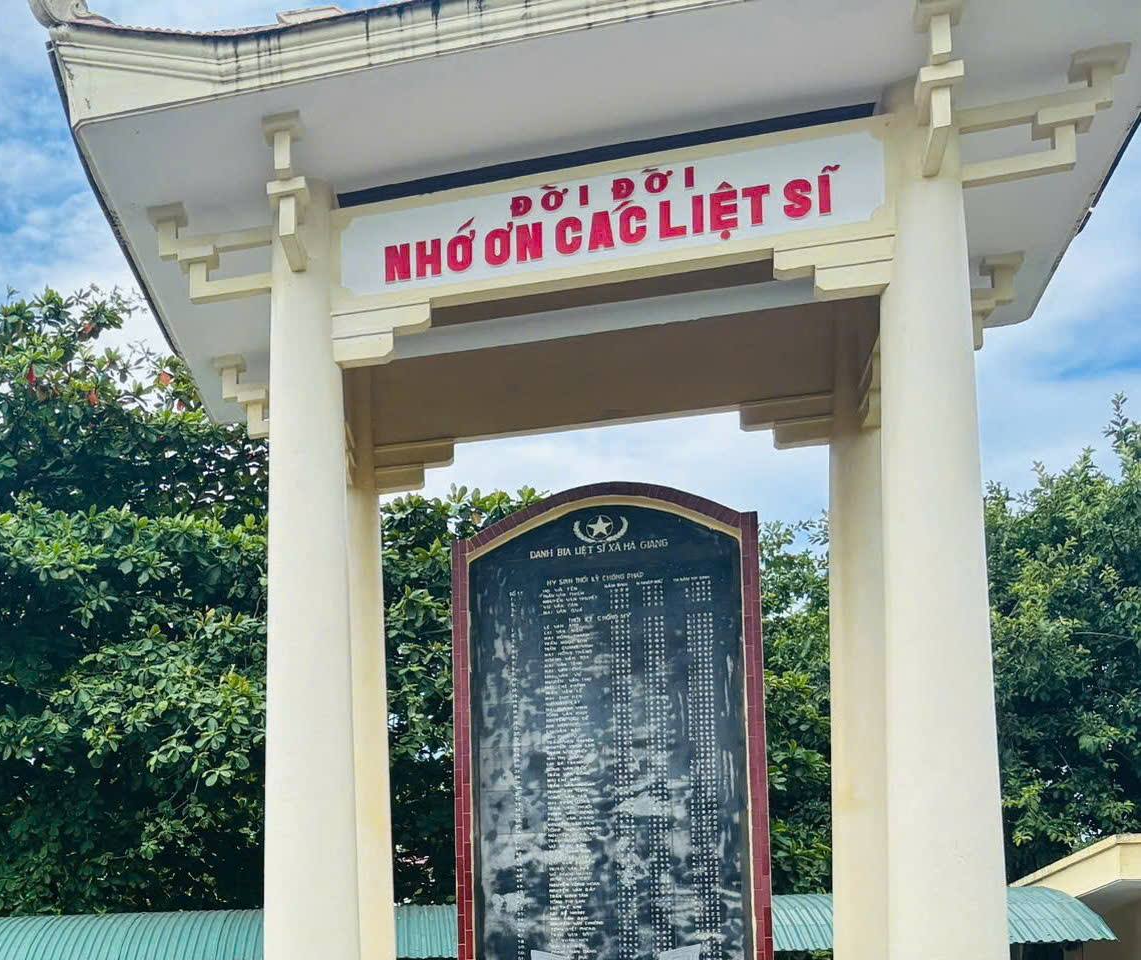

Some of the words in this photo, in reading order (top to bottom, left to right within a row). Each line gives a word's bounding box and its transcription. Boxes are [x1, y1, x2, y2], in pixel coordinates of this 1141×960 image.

[510, 183, 589, 218] ĐỜI
[611, 165, 695, 203] ĐỜI
[384, 216, 476, 285] NHỚ
[484, 220, 544, 266] ƠN
[555, 199, 647, 256] CÁC
[658, 179, 771, 242] LIỆT
[782, 163, 842, 220] SĨ
[529, 549, 553, 560] DANH
[557, 548, 572, 557] BIA
[574, 545, 593, 557] LIỆT
[639, 538, 668, 550] GIANG
